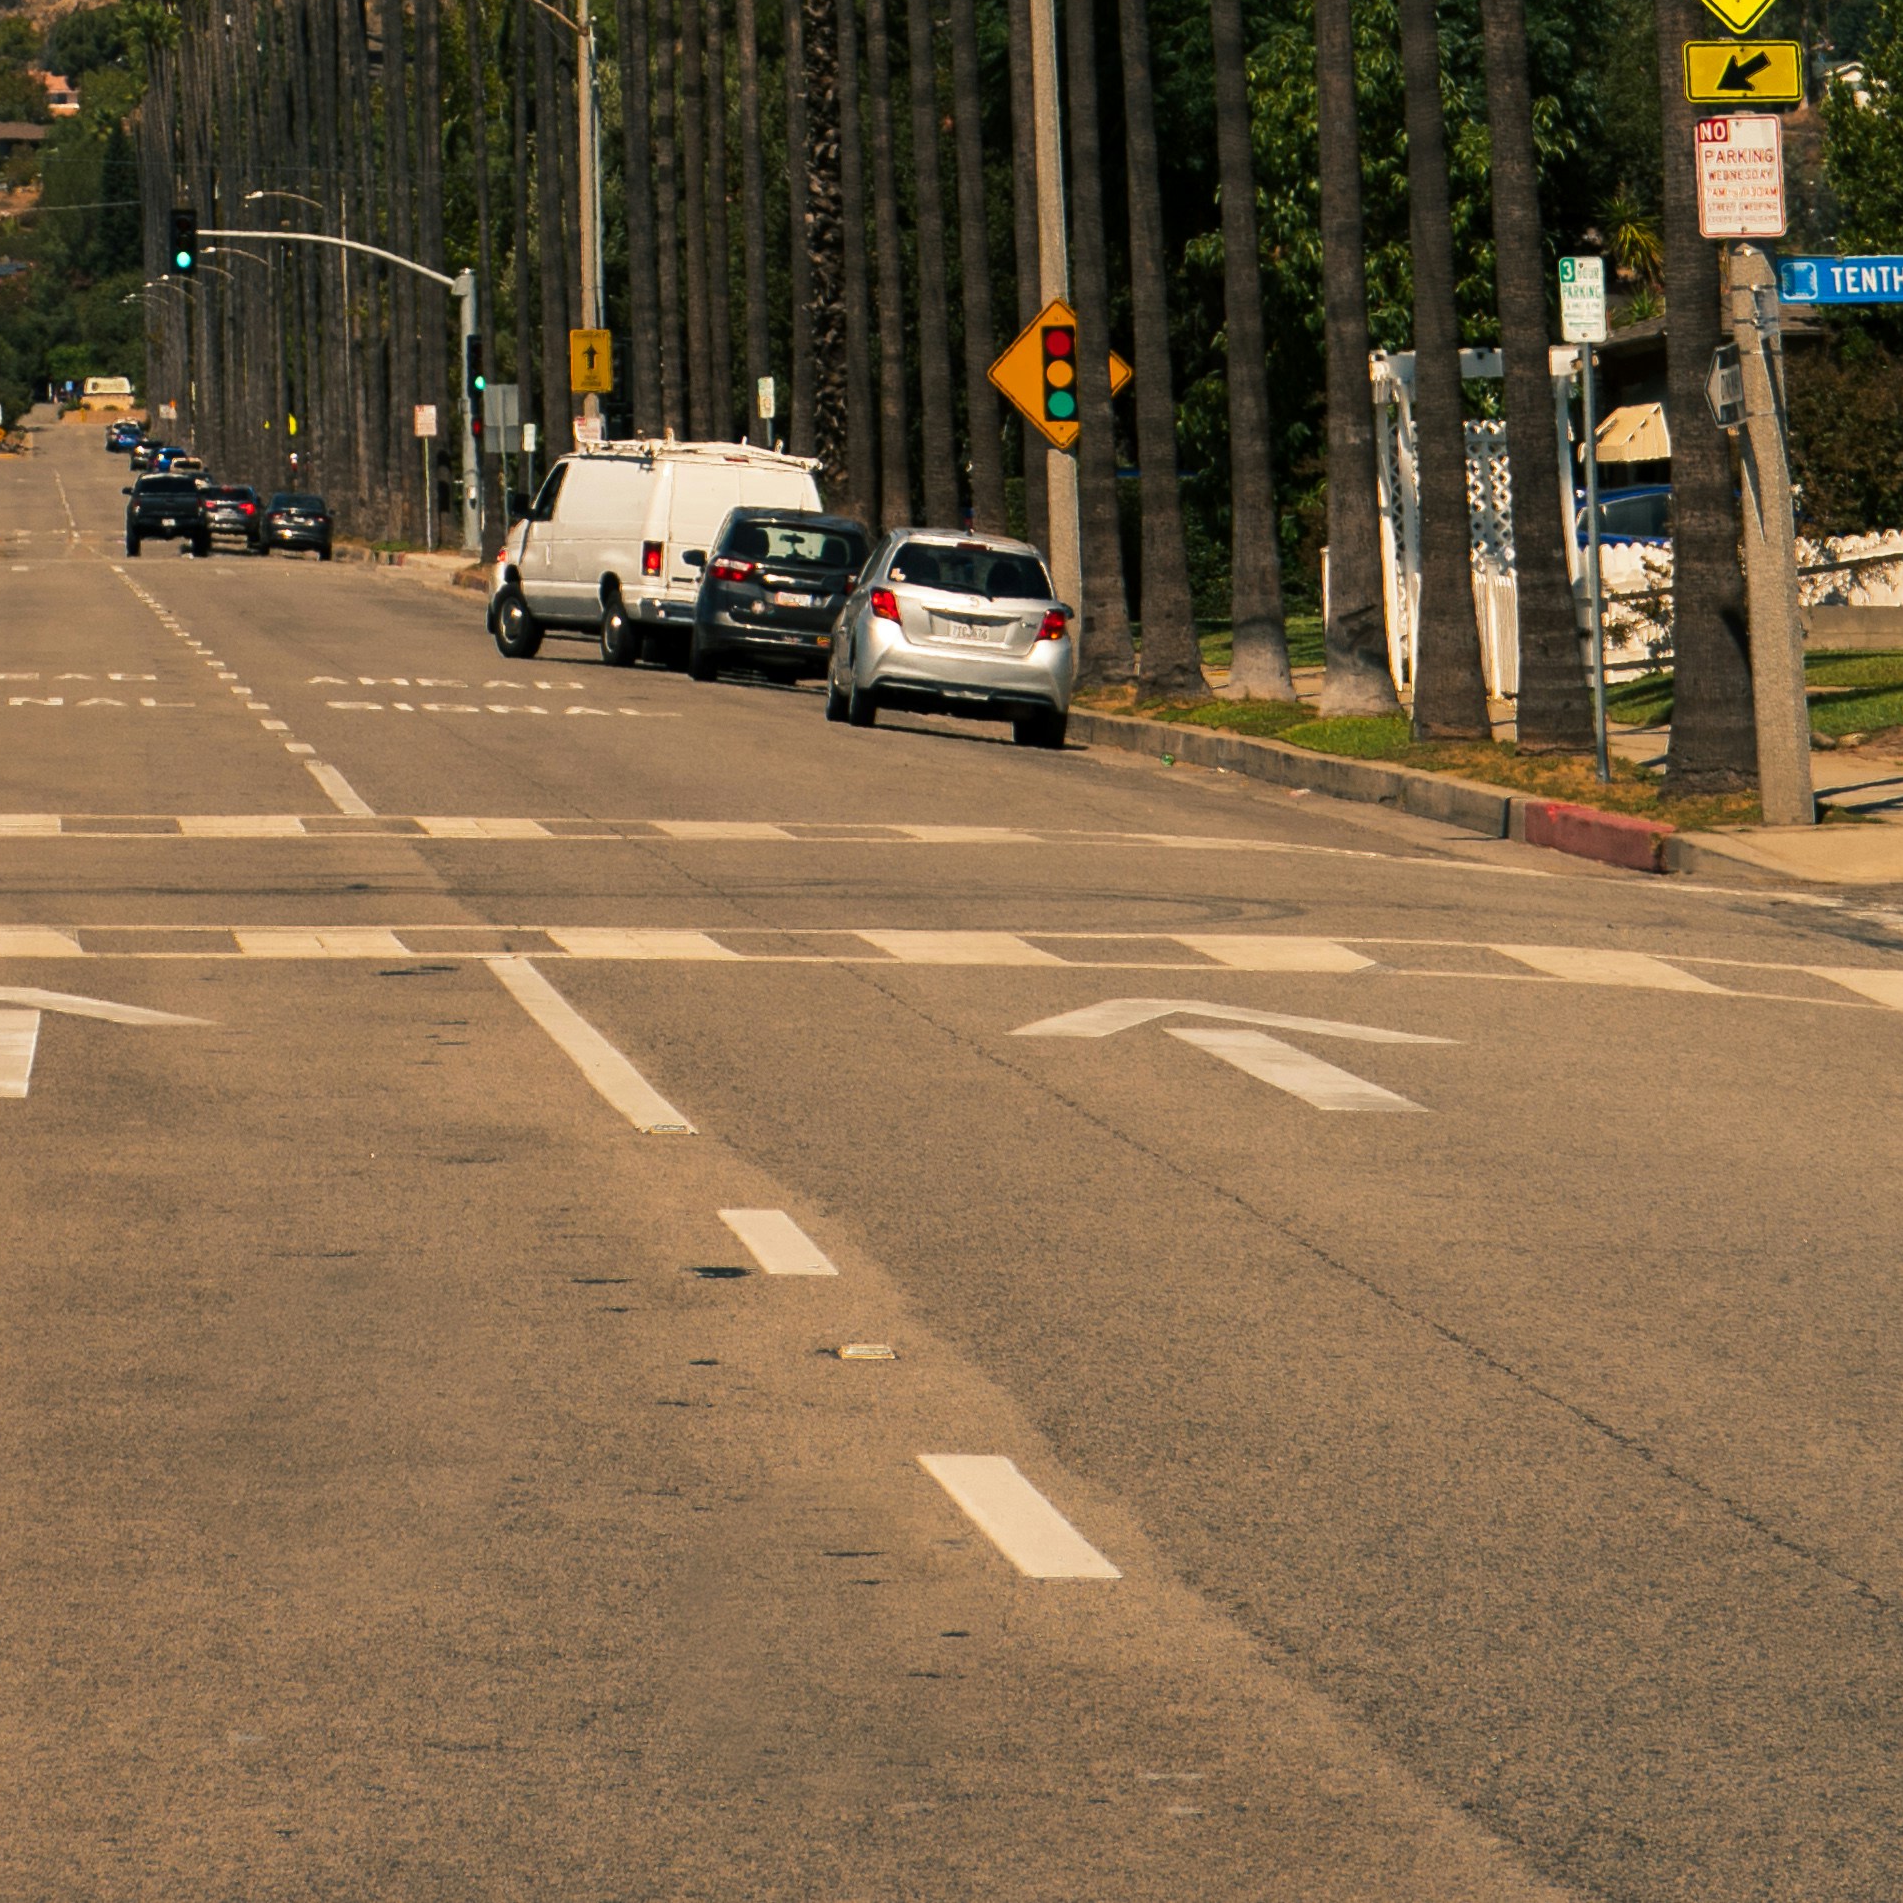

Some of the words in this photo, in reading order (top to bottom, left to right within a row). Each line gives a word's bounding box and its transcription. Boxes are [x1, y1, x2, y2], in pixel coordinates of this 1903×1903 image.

[1700, 122, 1726, 141] NO
[1704, 148, 1775, 164] PARKING
[1708, 169, 1773, 181] WEDNESDAY
[1562, 261, 1573, 280] 3
[1830, 266, 1903, 293] TENTH
[1563, 284, 1601, 300] PARKING
